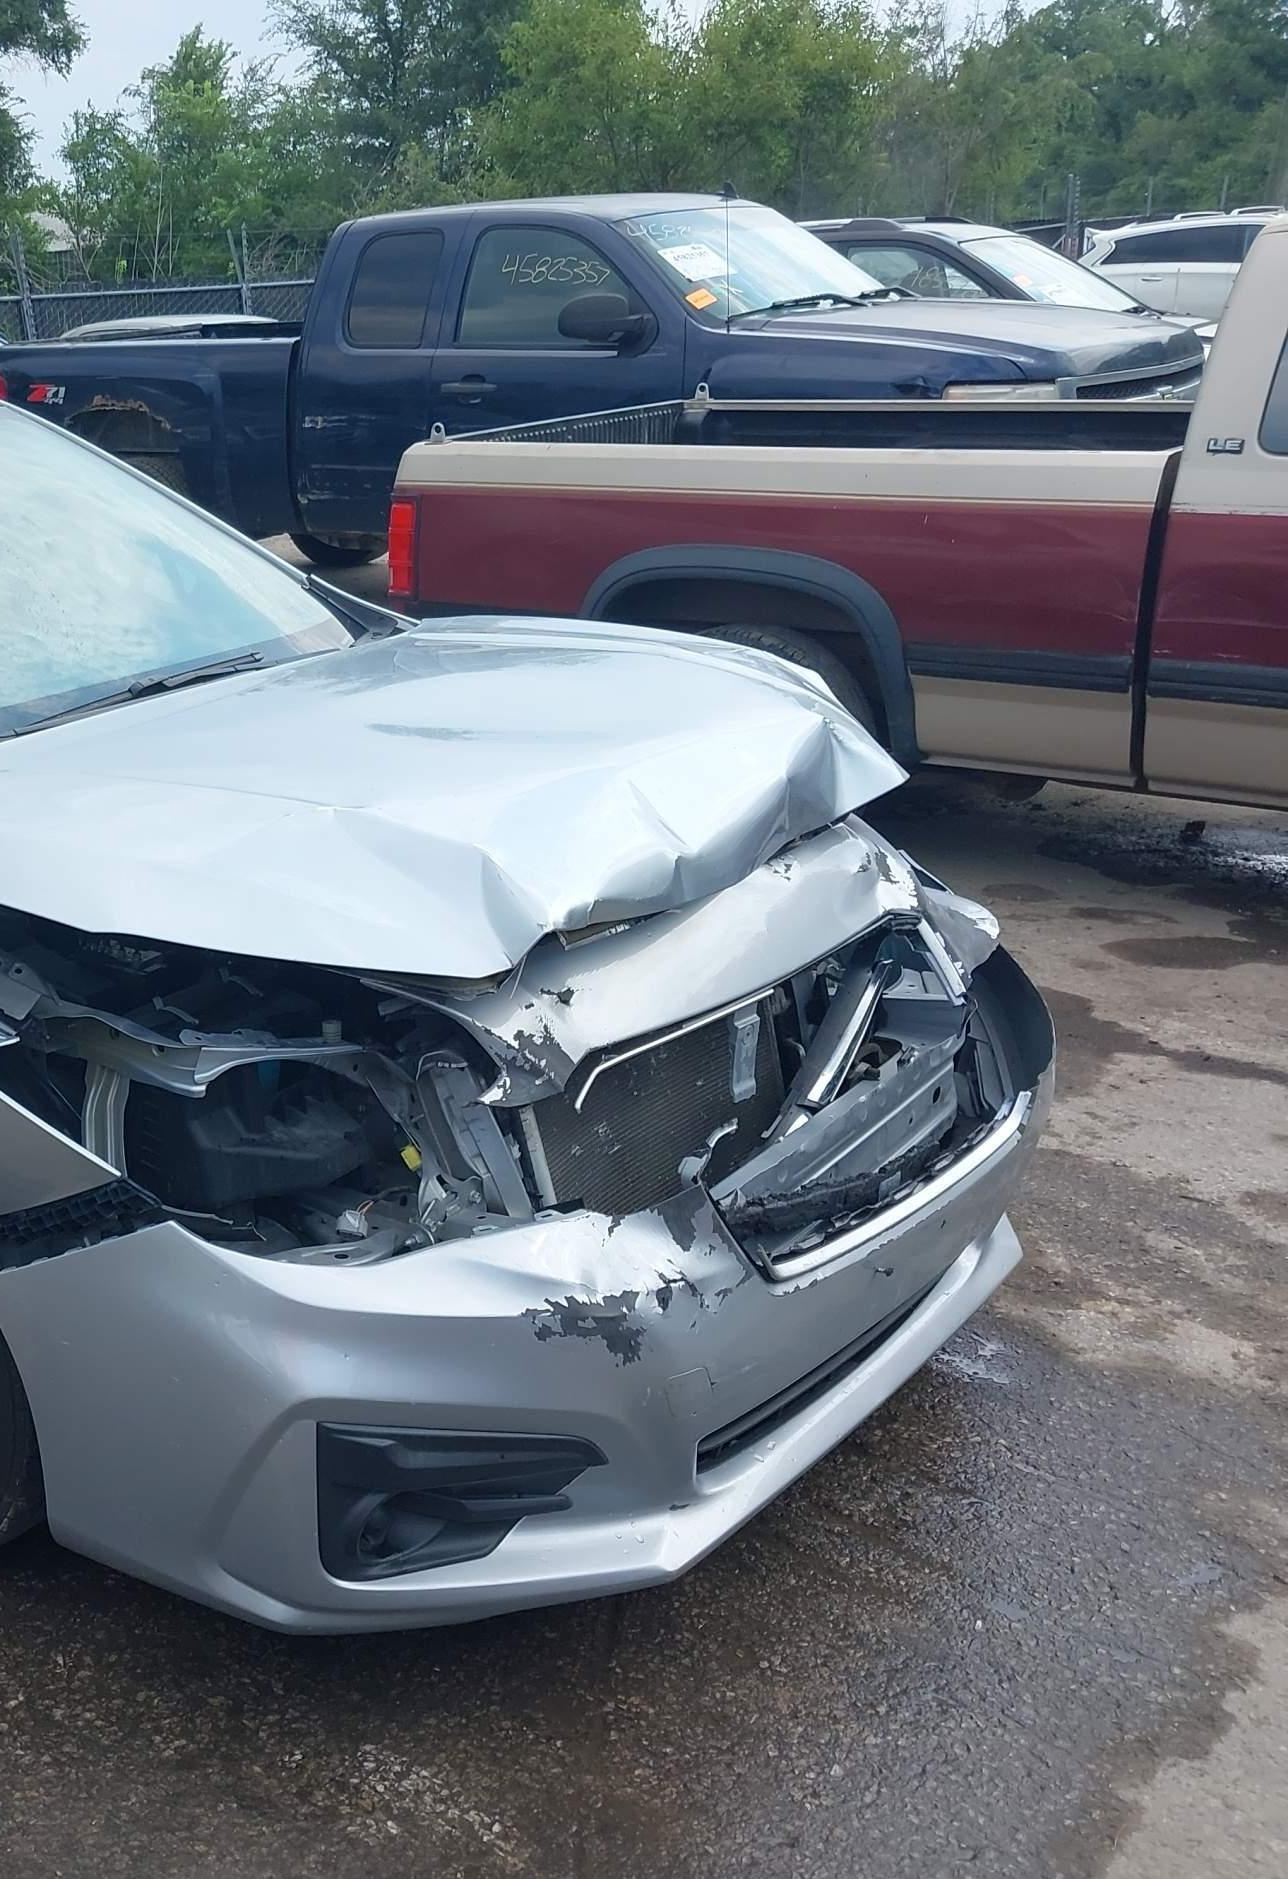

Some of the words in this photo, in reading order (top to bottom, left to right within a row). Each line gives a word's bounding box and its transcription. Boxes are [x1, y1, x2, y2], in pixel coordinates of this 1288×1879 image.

[502, 253, 610, 285] 45825357
[26, 384, 66, 402] Z71
[1207, 438, 1245, 454] LE
